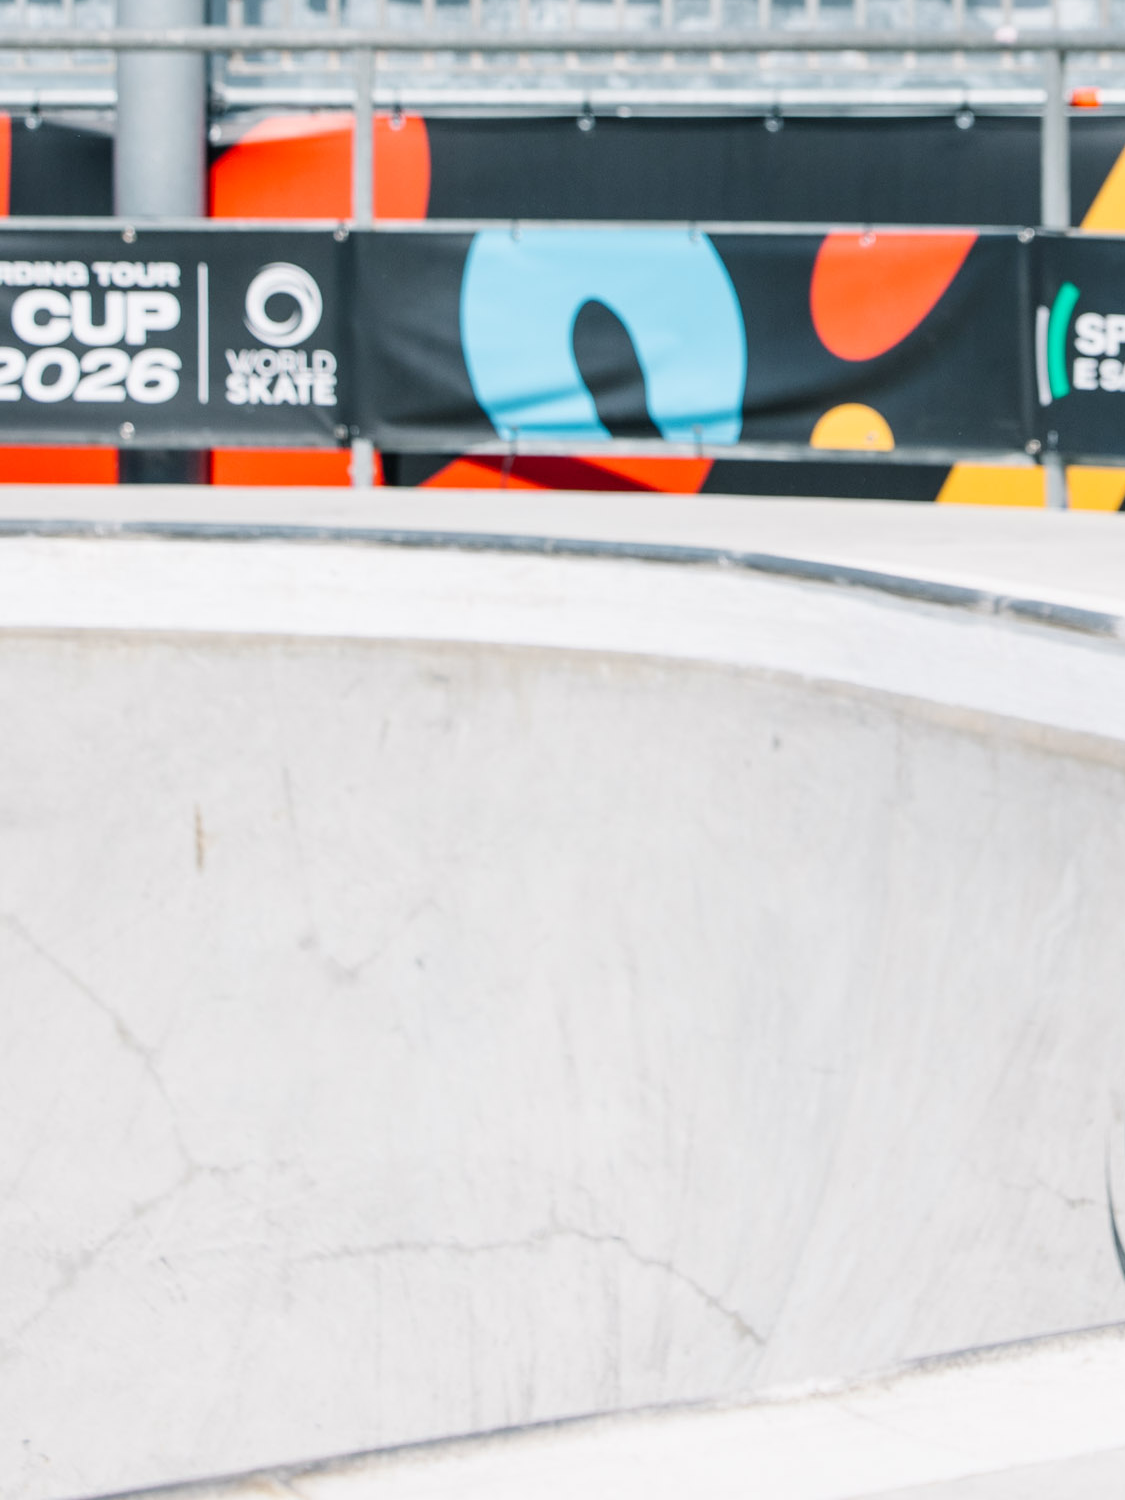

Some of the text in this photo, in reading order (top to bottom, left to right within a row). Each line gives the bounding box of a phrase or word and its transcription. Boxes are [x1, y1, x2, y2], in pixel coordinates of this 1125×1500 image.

[91, 261, 181, 287] TOUR
[11, 289, 181, 346] CUP
[225, 349, 337, 374] WORLD
[1072, 357, 1099, 391] E
[225, 371, 337, 406] SKATE
